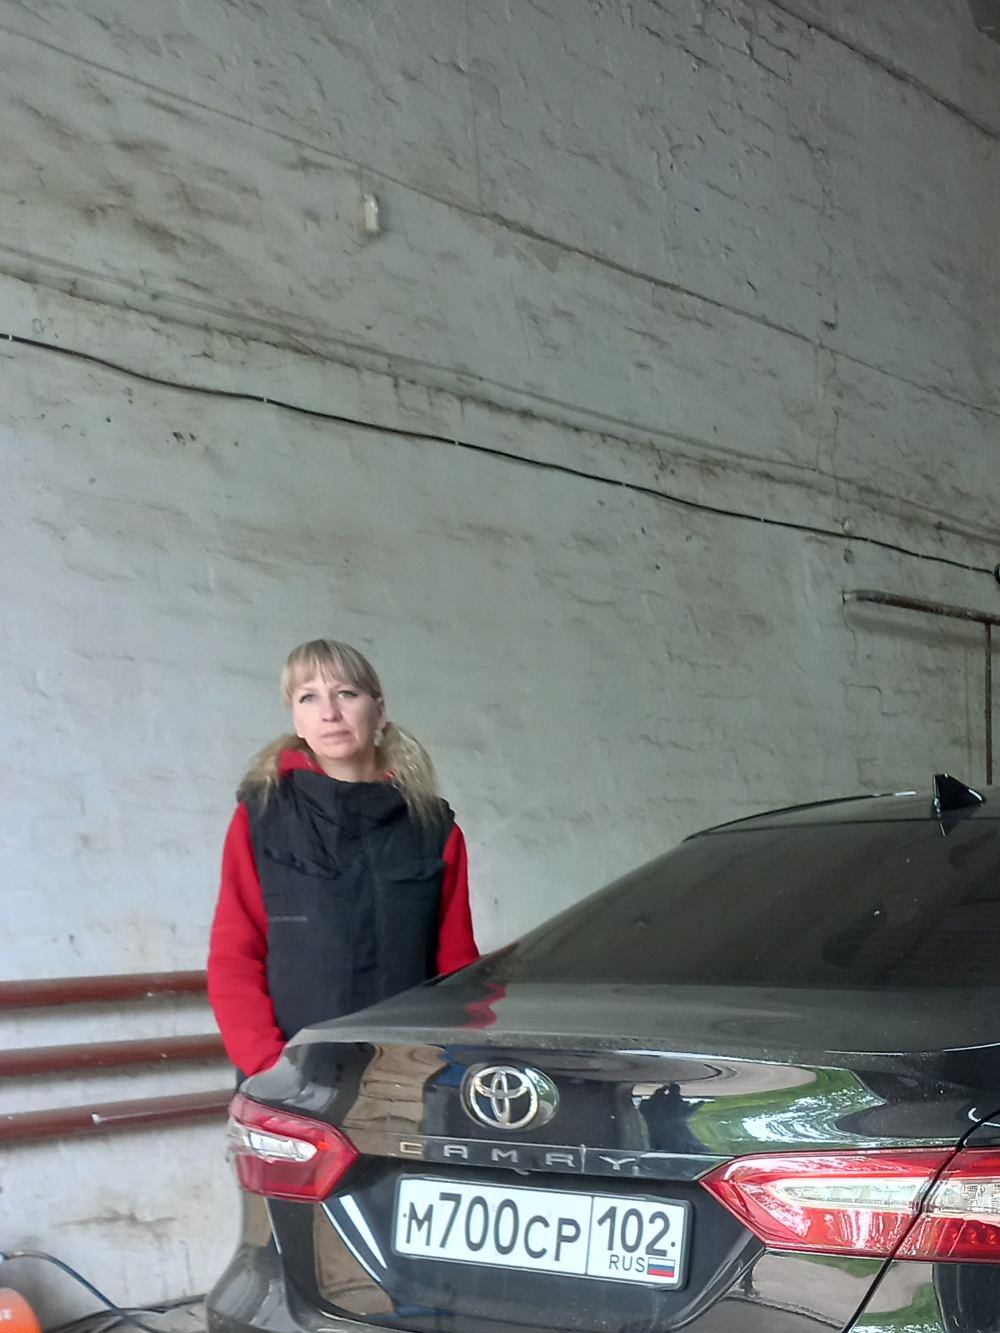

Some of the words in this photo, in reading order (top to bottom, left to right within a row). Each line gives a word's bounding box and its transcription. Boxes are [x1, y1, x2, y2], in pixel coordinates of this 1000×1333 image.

[399, 1141, 637, 1171] CAMRY
[596, 1206, 671, 1257] 102
[608, 1254, 646, 1273] RUS
